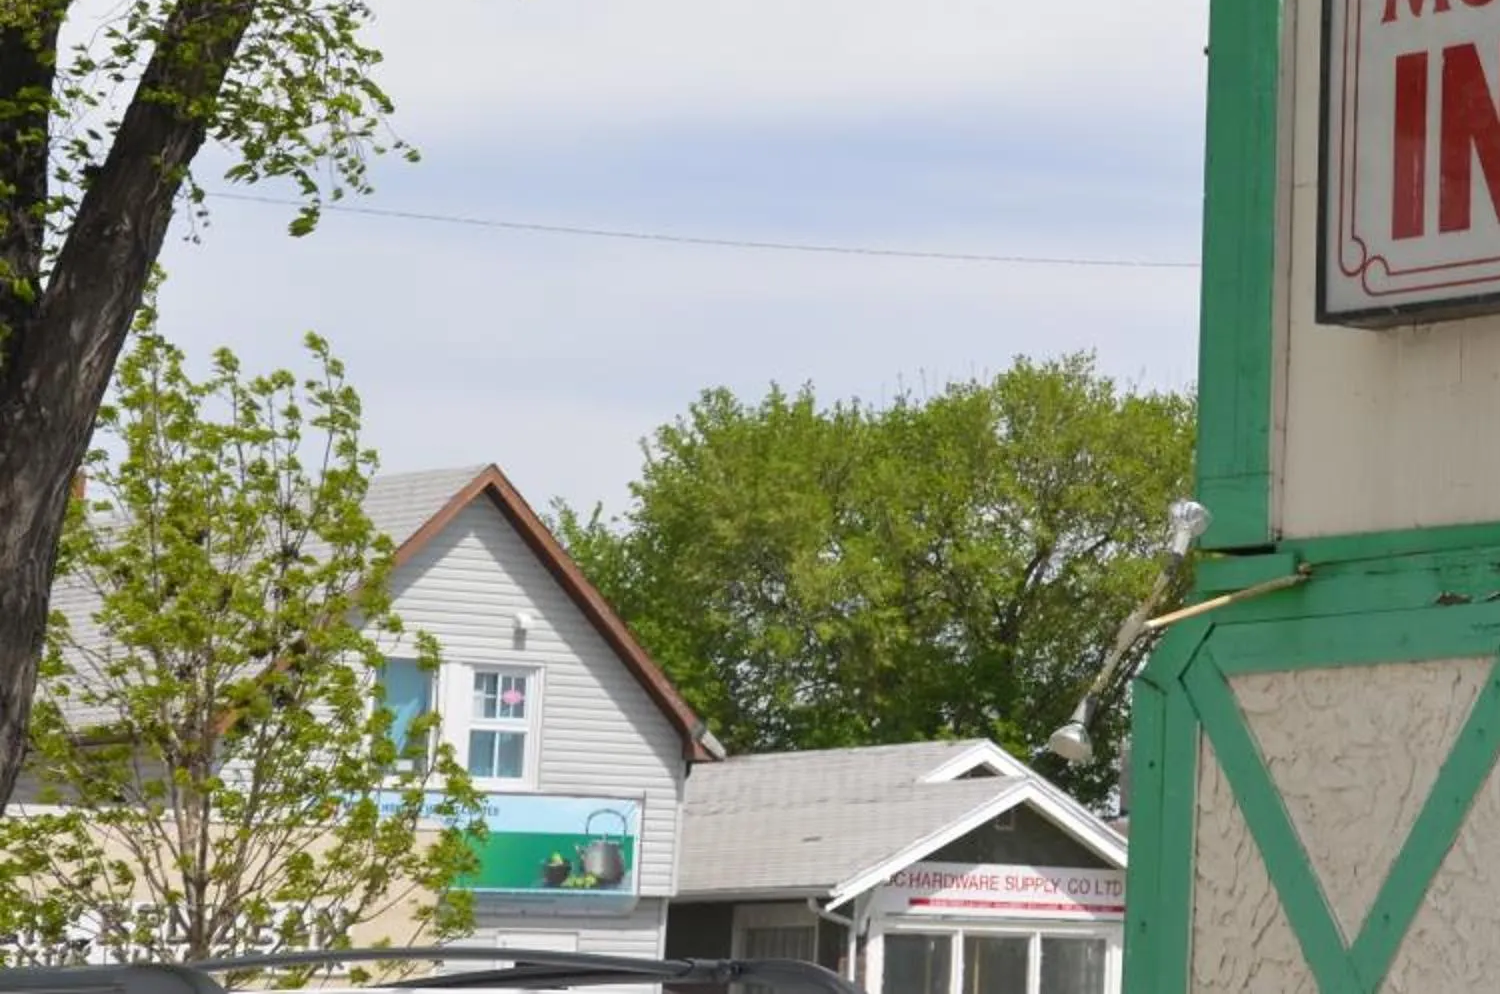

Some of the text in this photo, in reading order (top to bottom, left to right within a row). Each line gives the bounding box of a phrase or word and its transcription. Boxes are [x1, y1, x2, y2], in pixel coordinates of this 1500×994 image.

[908, 870, 1001, 892] HARDWARE
[1004, 874, 1062, 895] SUPPLY
[1067, 876, 1091, 897] CO
[1095, 878, 1124, 897] LTD
